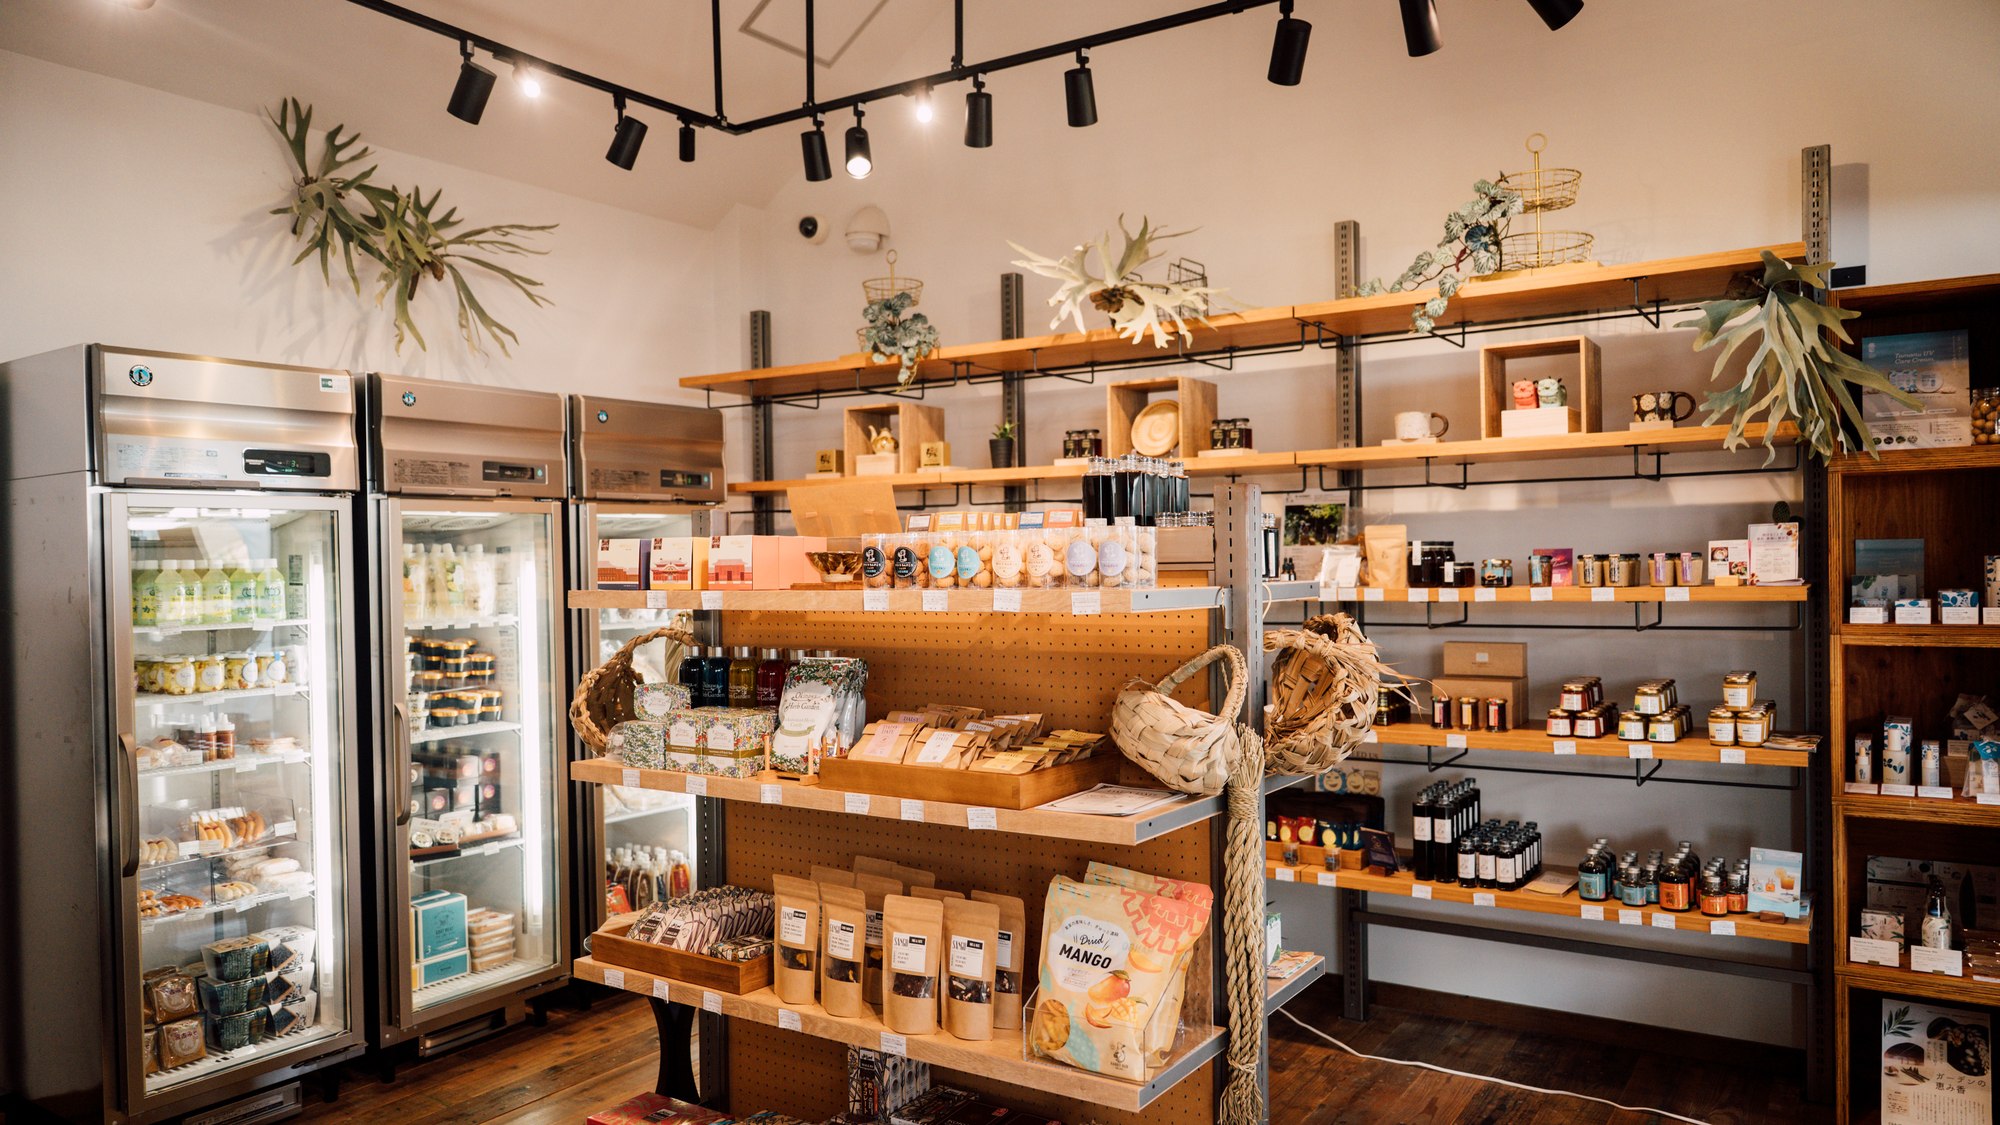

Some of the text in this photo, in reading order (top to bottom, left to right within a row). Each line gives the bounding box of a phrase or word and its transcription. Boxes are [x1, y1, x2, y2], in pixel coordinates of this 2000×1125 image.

[1080, 933, 1104, 945] Dried
[1059, 943, 1112, 969] MANGO
[1936, 1072, 1986, 1088] ガーデンの
